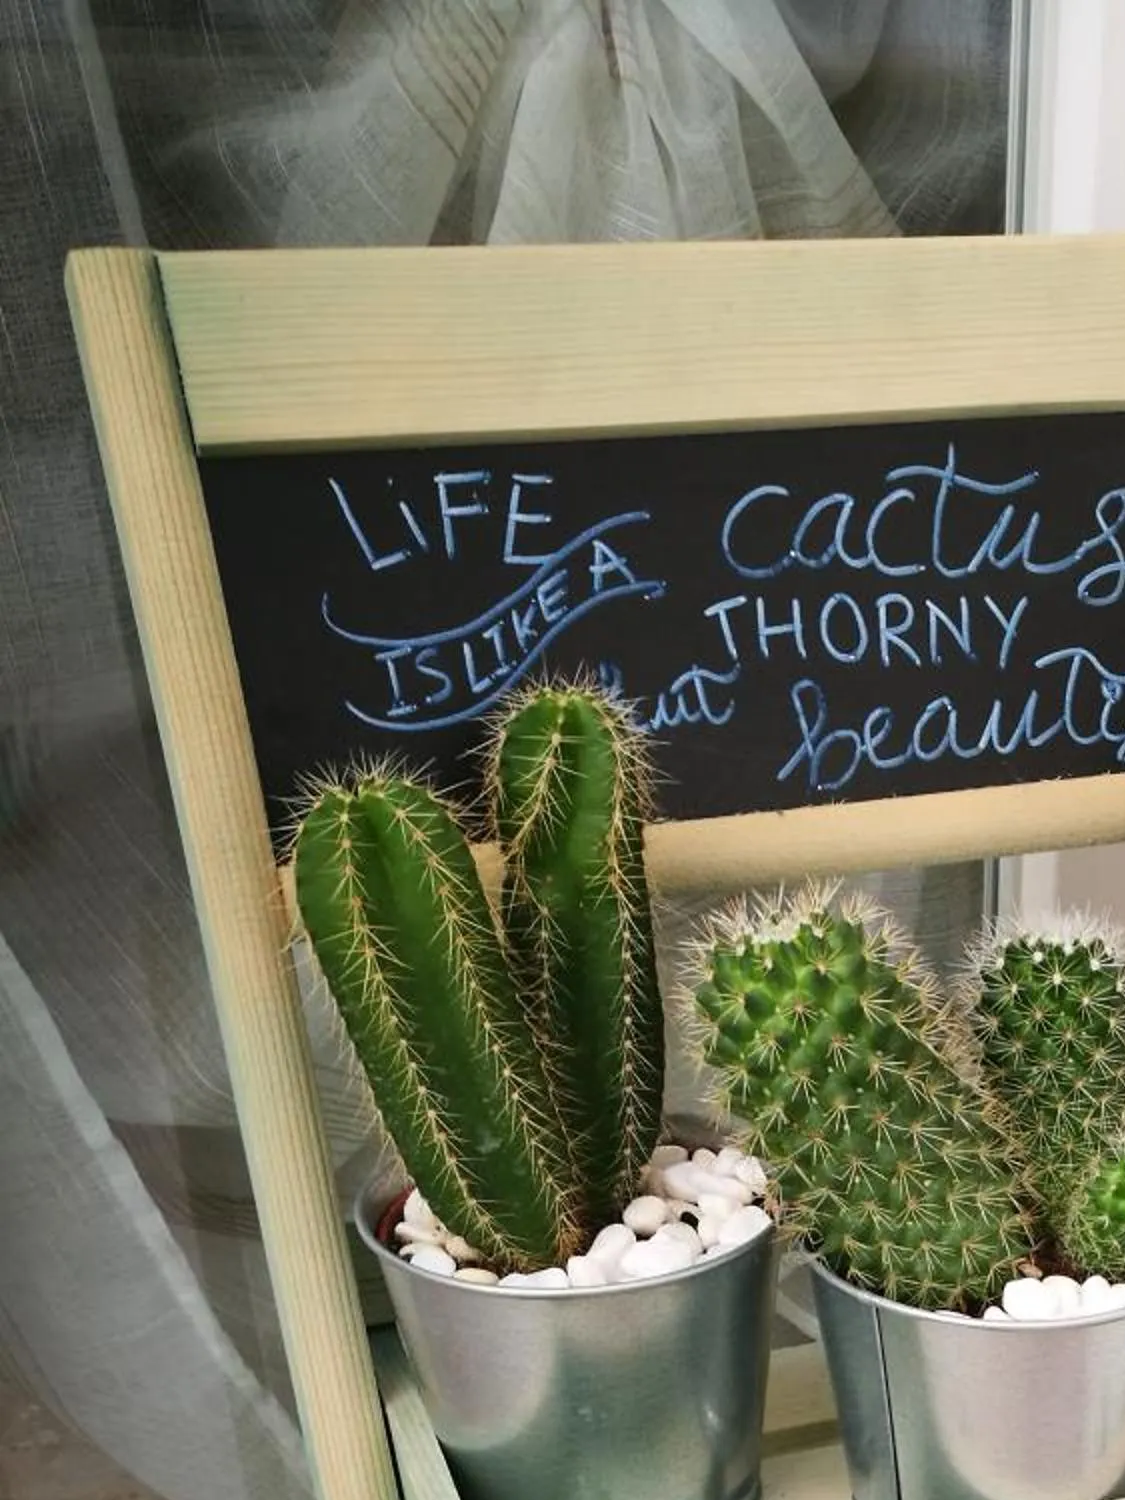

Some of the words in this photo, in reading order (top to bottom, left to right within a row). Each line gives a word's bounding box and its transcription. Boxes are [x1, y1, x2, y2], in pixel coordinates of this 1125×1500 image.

[461, 568, 569, 694] LIKE
[588, 539, 638, 593] A
[703, 595, 1028, 668] THORNY
